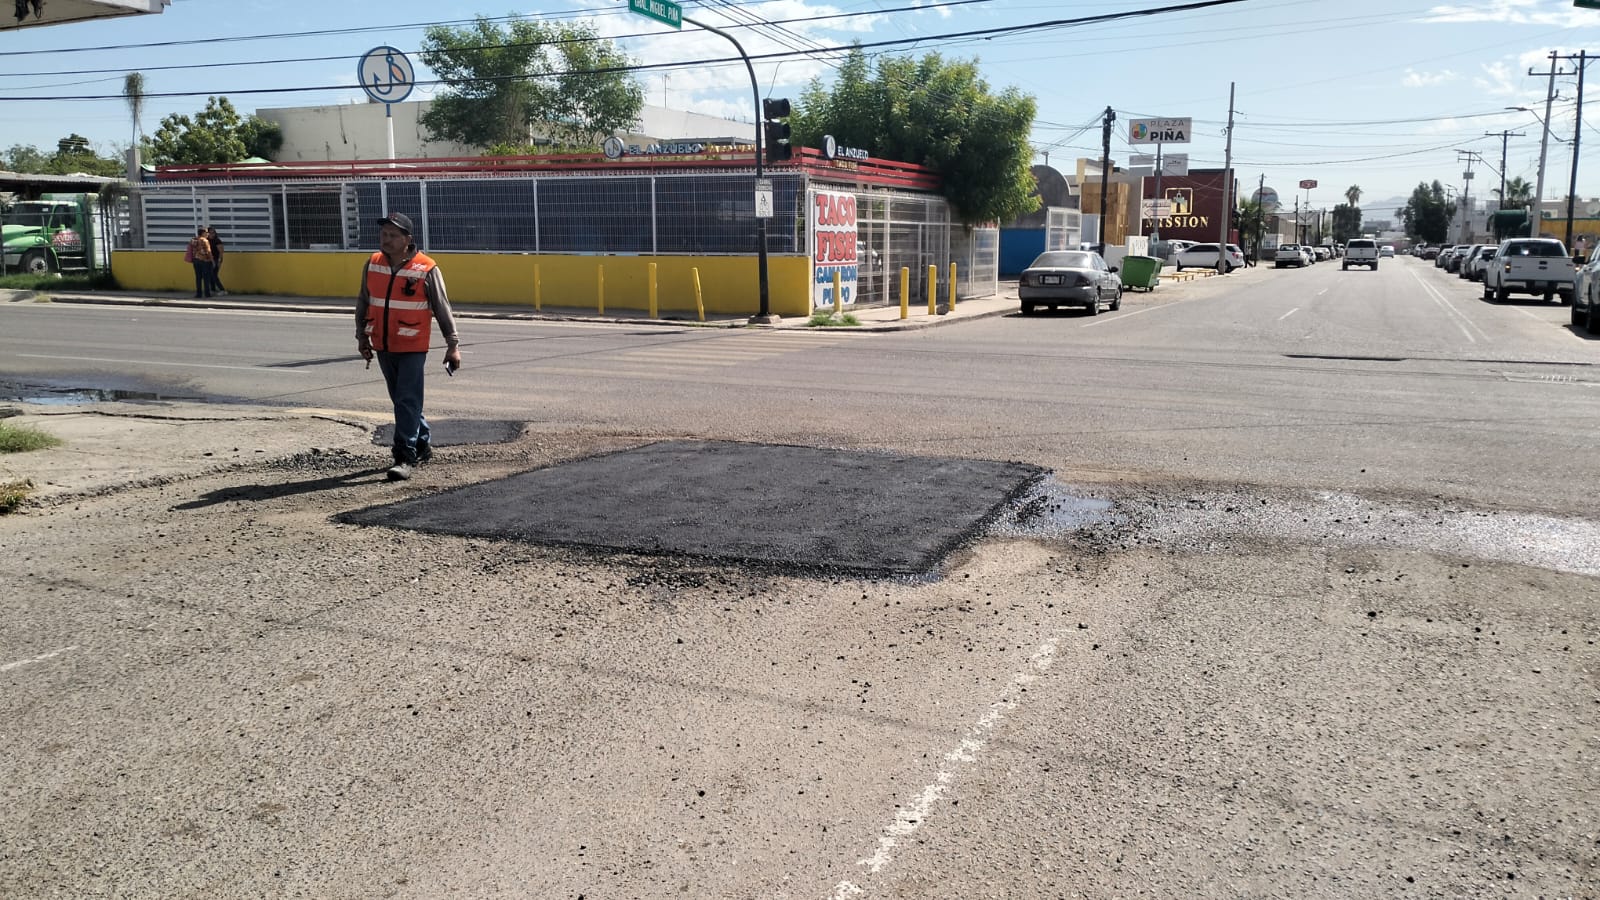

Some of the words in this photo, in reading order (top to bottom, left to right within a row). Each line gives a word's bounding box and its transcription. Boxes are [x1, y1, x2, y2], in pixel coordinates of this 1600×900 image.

[650, 0, 666, 17] MIGUEL
[1150, 128, 1184, 141] PIÑA
[629, 145, 641, 154] EL
[646, 143, 701, 154] ANZUELO
[838, 146, 844, 156] EL
[846, 147, 868, 160] ANZUELO
[816, 194, 855, 225] TACO
[816, 231, 856, 262] FISH
[822, 287, 849, 304] PUPO
